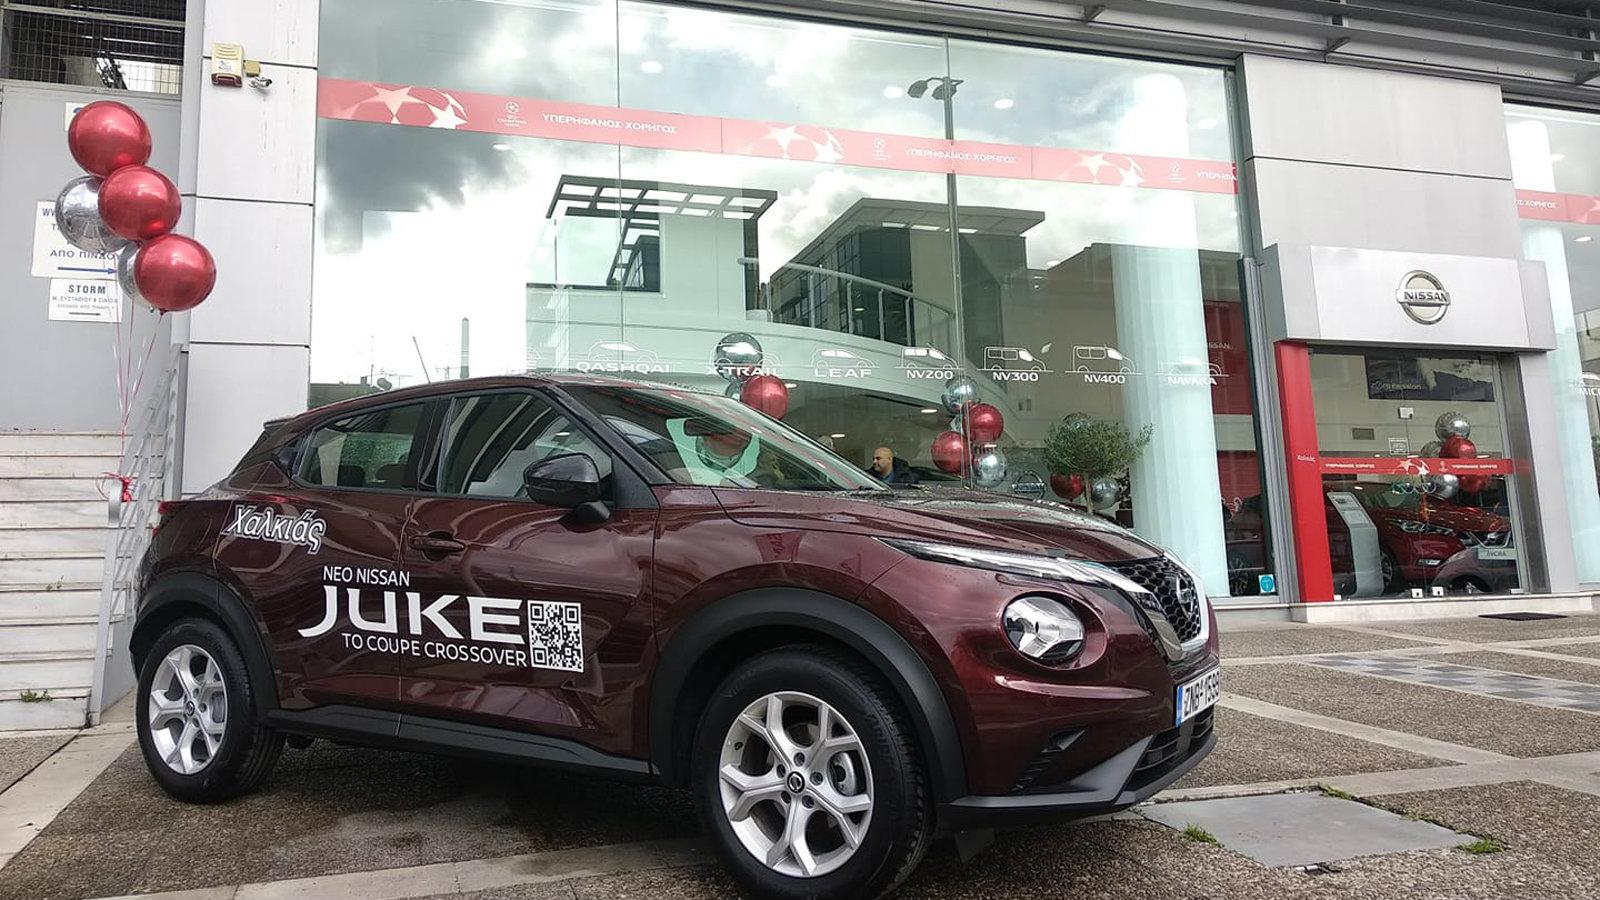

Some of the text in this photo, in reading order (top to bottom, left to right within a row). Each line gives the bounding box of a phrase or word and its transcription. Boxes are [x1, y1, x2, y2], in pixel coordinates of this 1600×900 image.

[542, 112, 621, 129] ΥΠΕΡΗΦΑΝΟΣ
[624, 121, 677, 133] ΧΟΡΗΓΟΣ
[50, 249, 75, 258] ΑΠΟ
[68, 284, 106, 294] STORM
[1404, 291, 1450, 302] NISSAN
[576, 361, 671, 374] QASHQAI
[815, 369, 871, 379] LEAF
[907, 369, 953, 380] NV200
[992, 371, 1039, 382] NV300
[1084, 374, 1126, 384] NV400
[1168, 377, 1217, 385] NAVARA
[226, 506, 326, 552] Χαλκιάς
[356, 568, 410, 587] NISSAN
[296, 585, 525, 645] JUKE
[366, 636, 421, 657] COUPE
[424, 642, 528, 668] CROSSOVER
